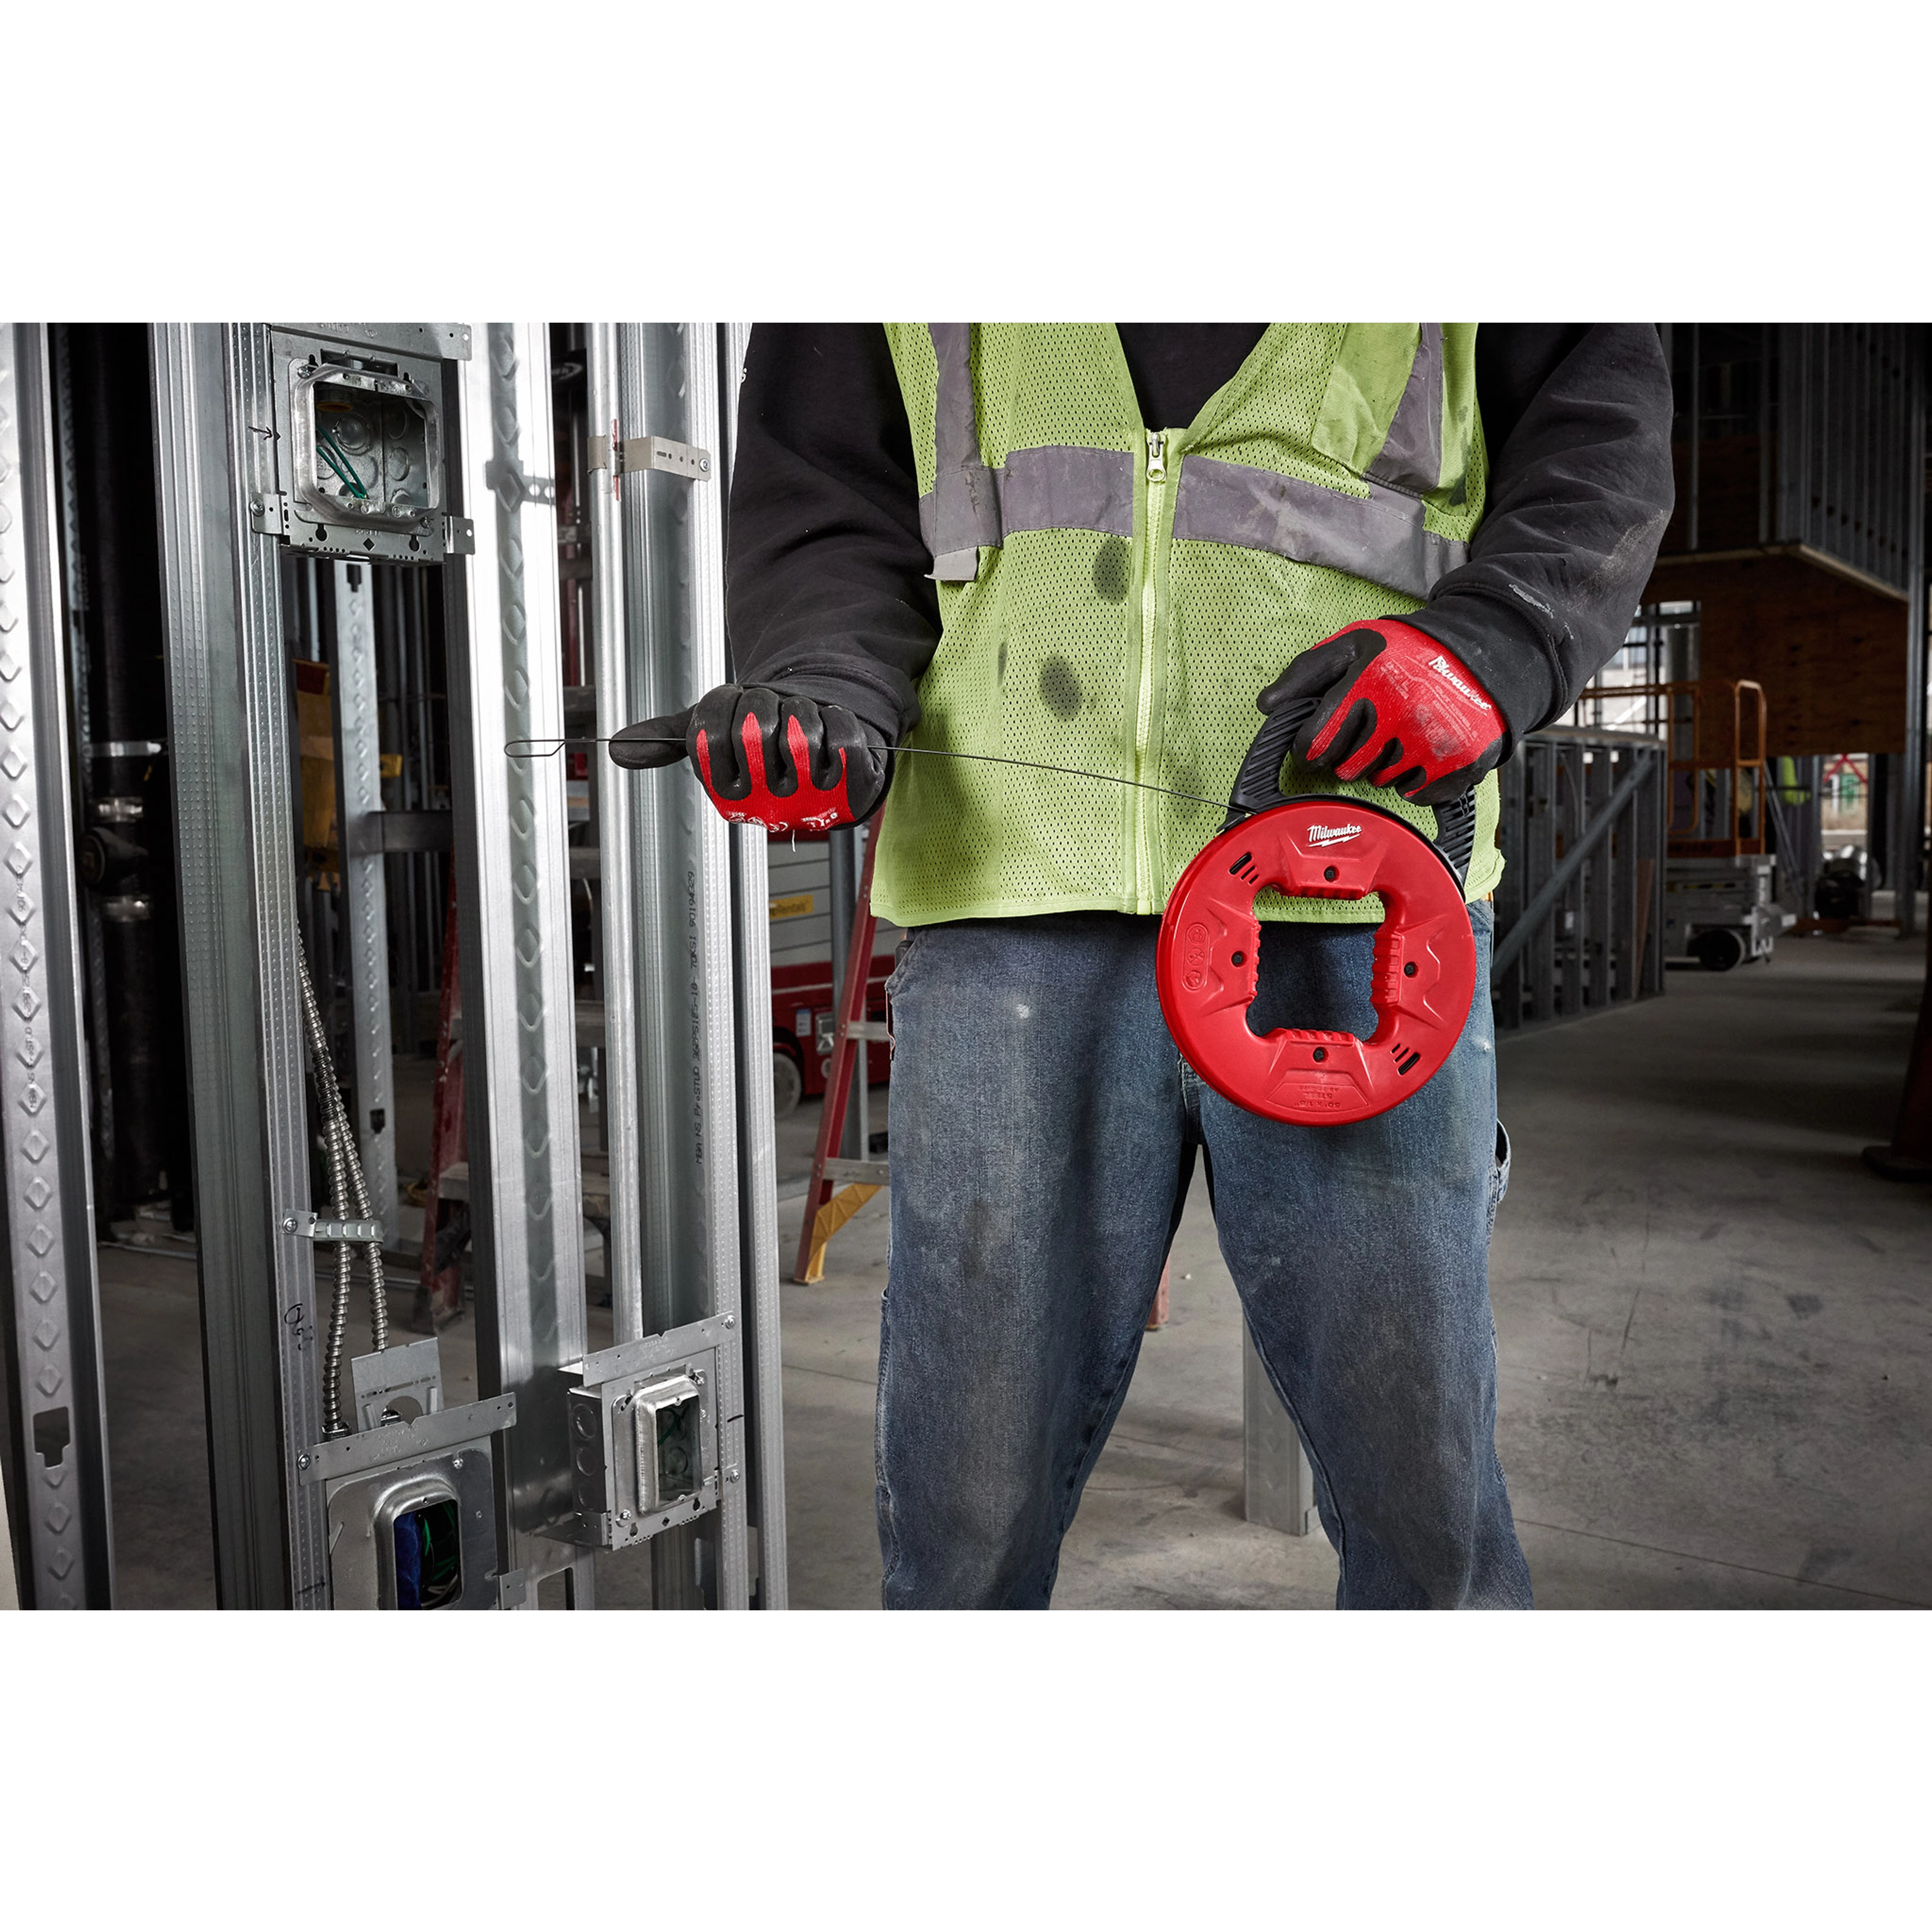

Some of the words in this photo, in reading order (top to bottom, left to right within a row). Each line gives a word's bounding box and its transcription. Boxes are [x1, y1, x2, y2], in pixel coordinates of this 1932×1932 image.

[1307, 823, 1362, 842] Milwaukee
[687, 871, 696, 928] 90194329
[693, 1066, 701, 1117] ProSTUD
[694, 1122, 702, 1137] NS
